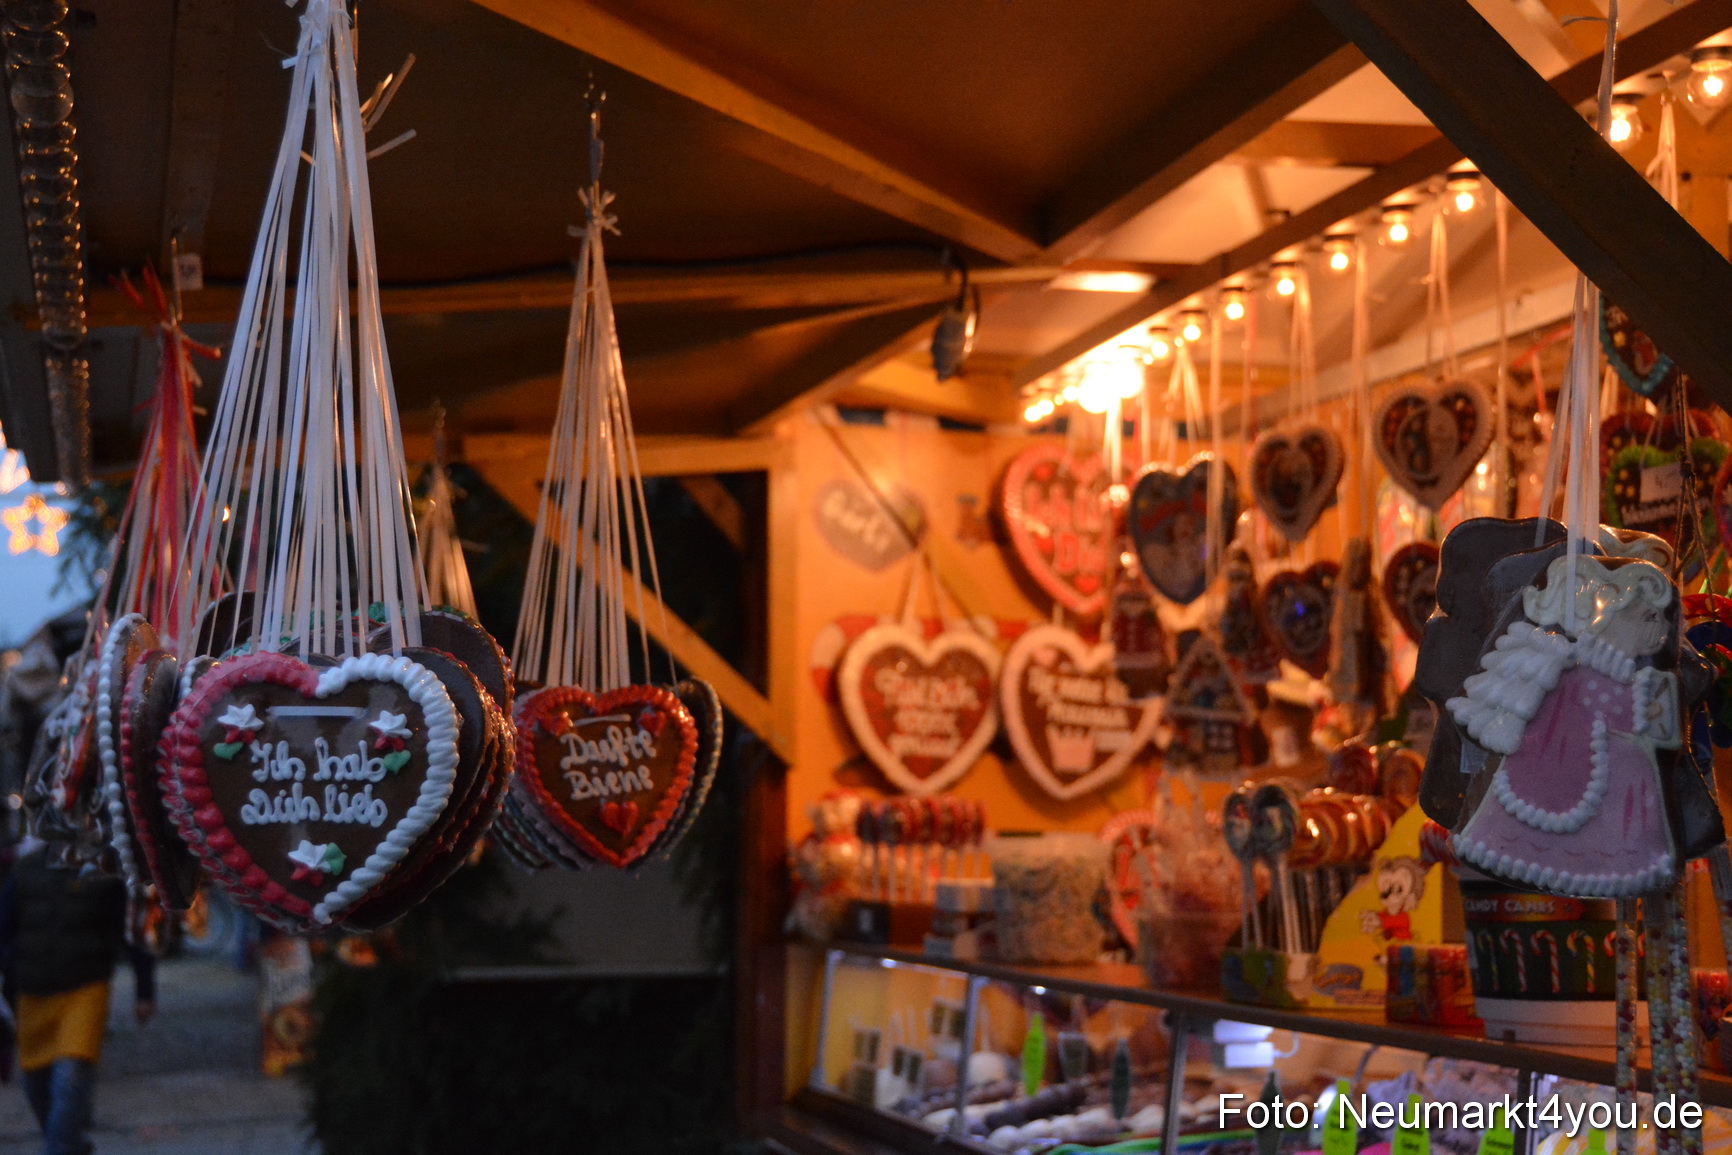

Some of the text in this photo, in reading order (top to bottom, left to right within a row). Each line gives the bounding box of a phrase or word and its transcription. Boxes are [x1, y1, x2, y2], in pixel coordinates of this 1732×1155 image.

[249, 736, 389, 783] Ich hab
[563, 764, 655, 801] Biene
[240, 781, 389, 828] Dich lieb
